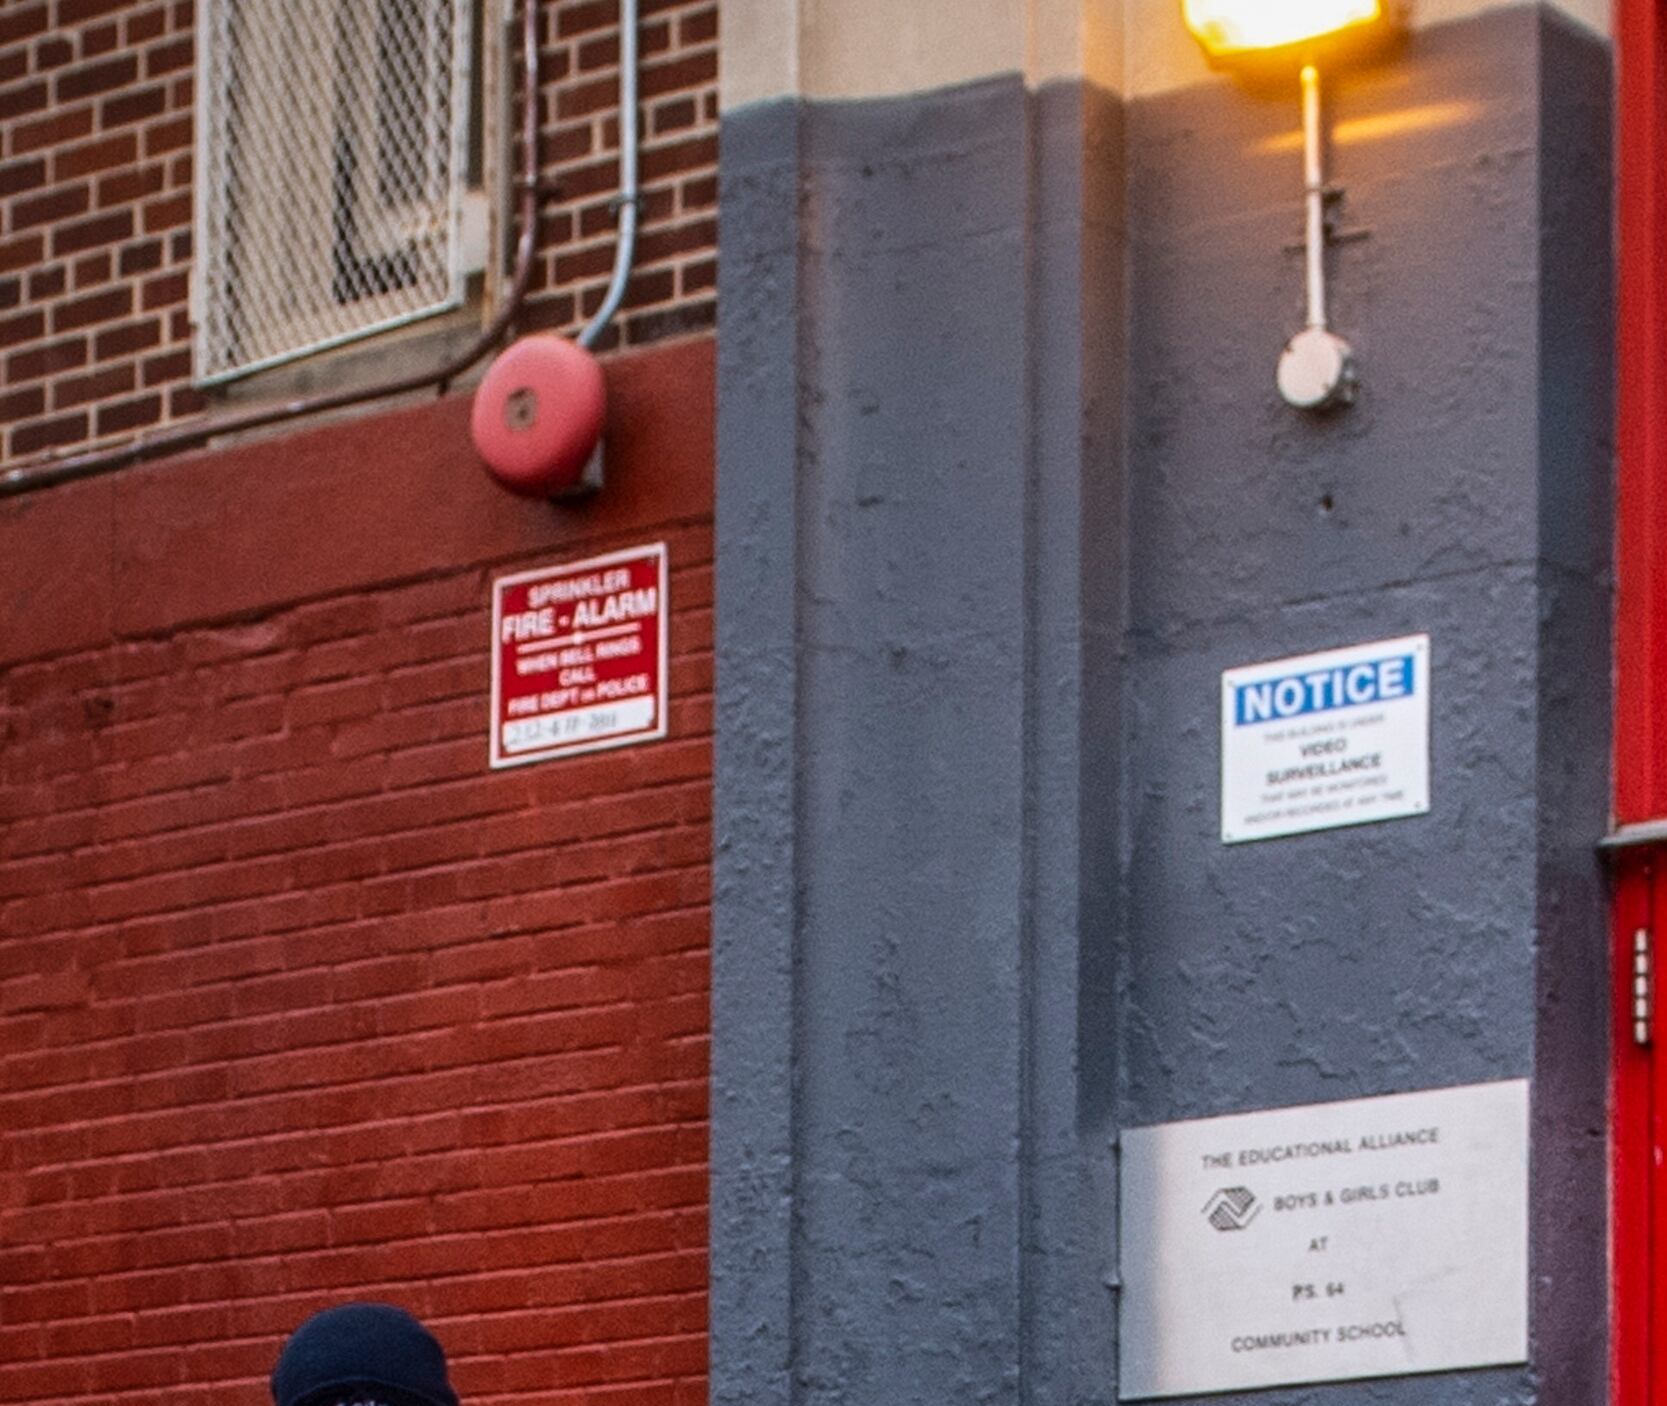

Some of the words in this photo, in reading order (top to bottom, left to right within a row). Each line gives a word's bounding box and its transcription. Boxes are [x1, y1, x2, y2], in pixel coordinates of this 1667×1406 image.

[528, 569, 630, 608] SPRINKLER
[502, 607, 555, 643] FIRE
[572, 587, 657, 627] ALARM
[516, 651, 557, 675] WHEN
[559, 644, 593, 667] BELL
[558, 666, 597, 687] CALL
[597, 672, 649, 698] POLICE
[1242, 658, 1406, 722] NOTICE
[1301, 737, 1348, 757] VIDEO
[1266, 752, 1382, 786] SURVEILLANCE
[1202, 1153, 1233, 1170] THE
[1238, 1139, 1352, 1167] EDUCATIONAL
[1357, 1127, 1440, 1153] ALLIANCE
[1273, 1193, 1318, 1212] BOYS
[1323, 1192, 1335, 1207] &
[1340, 1184, 1390, 1206] GIRLS
[1395, 1178, 1440, 1197] CLUB
[1308, 1236, 1328, 1253] AT
[1325, 1282, 1345, 1297] 64
[1231, 1326, 1331, 1353] COMMUNITY
[1336, 1320, 1406, 1343] SCHOOL
